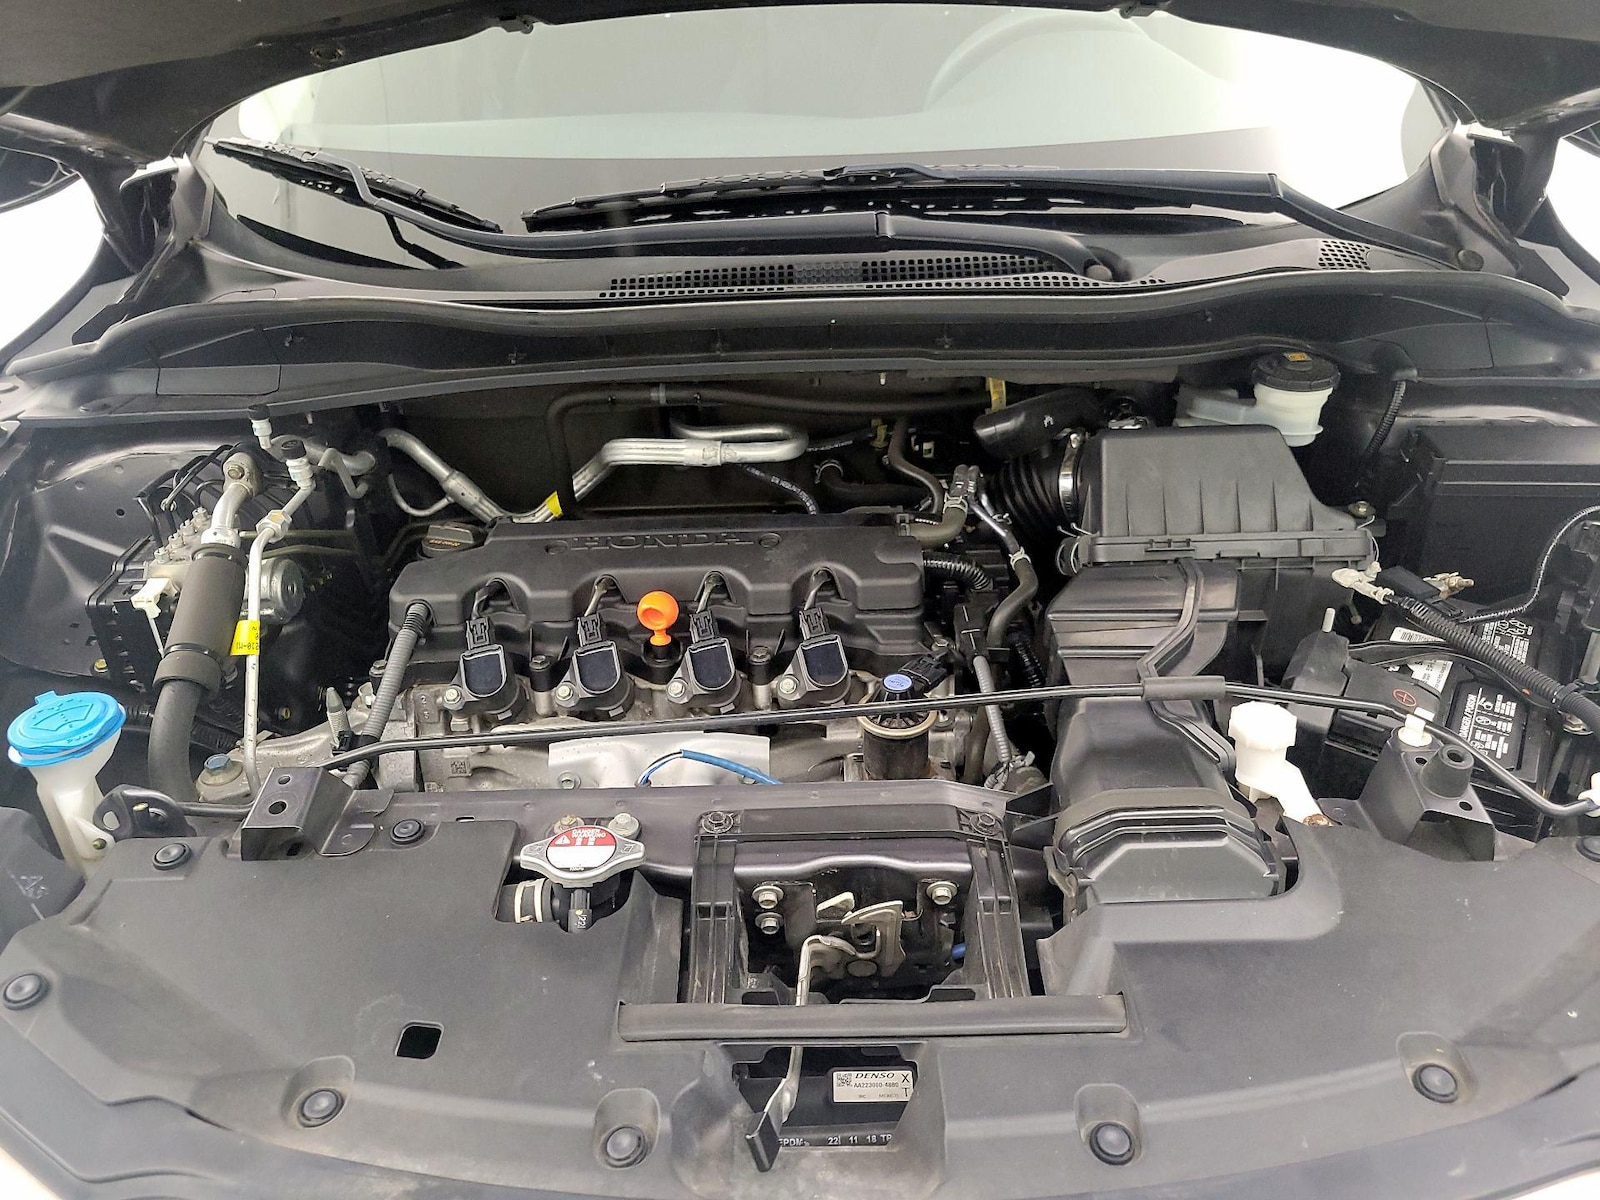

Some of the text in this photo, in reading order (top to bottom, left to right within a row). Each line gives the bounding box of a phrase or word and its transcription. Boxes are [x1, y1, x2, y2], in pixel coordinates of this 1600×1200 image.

[570, 533, 754, 550] HONDA
[901, 1073, 910, 1083] X
[901, 1087, 911, 1097] T
